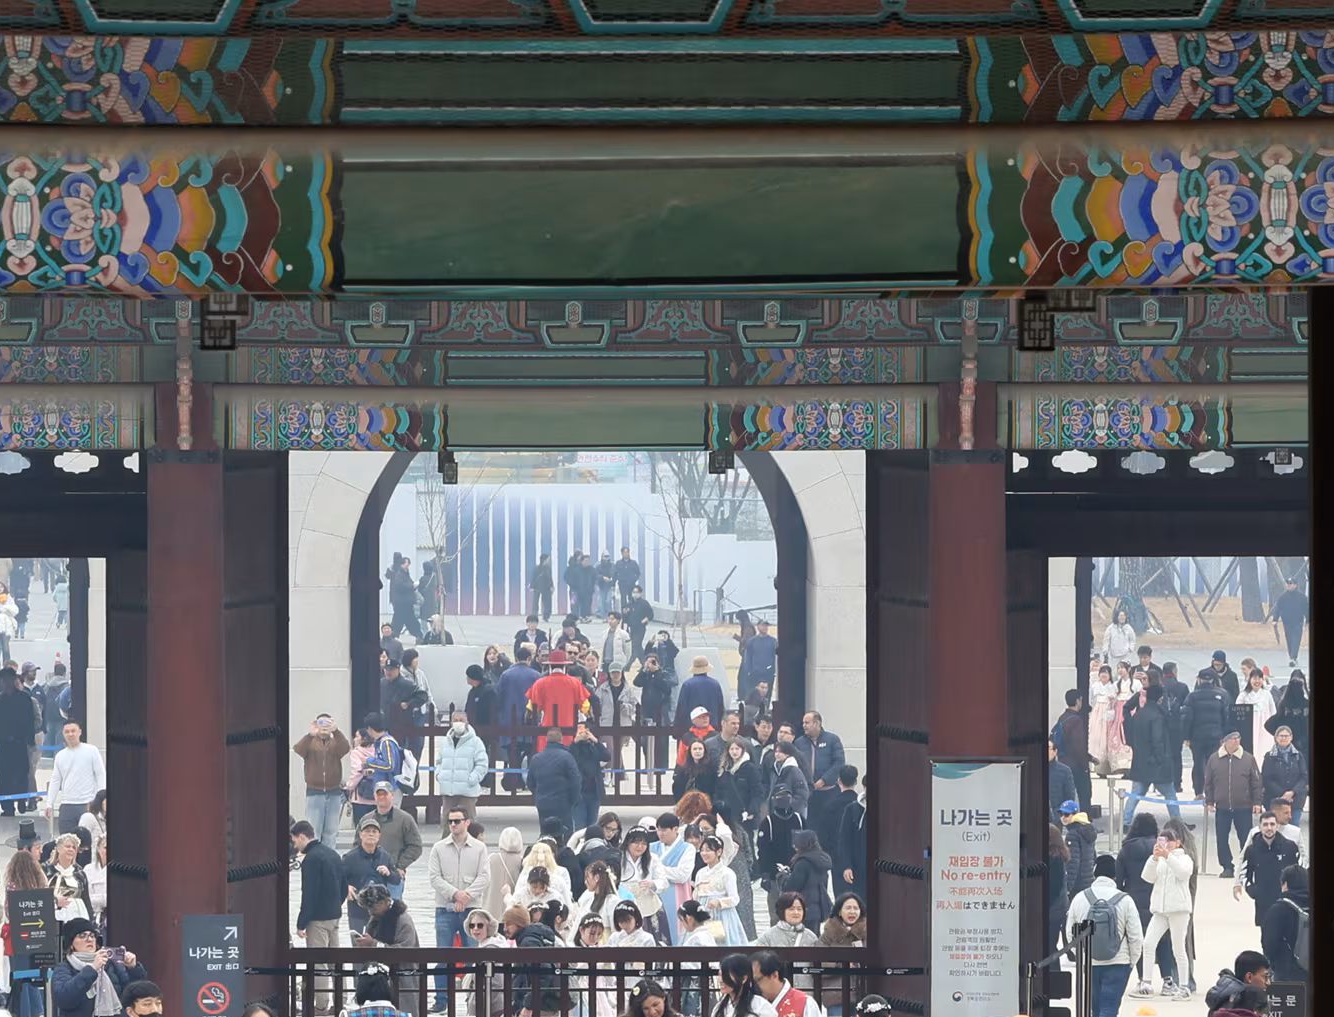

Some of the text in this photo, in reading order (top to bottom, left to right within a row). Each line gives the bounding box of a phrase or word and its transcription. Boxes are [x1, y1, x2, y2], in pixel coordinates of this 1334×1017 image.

[940, 809, 1012, 826] 나가는 곳
[961, 831, 991, 842] (Exit)
[948, 855, 1004, 868] 재입장 불가
[940, 869, 1011, 883] No re-entry
[949, 887, 1003, 896] 不能再次入场
[18, 900, 44, 908] 나가는 곳
[189, 946, 240, 959] 나가는 곳
[1285, 994, 1297, 1007] 문
